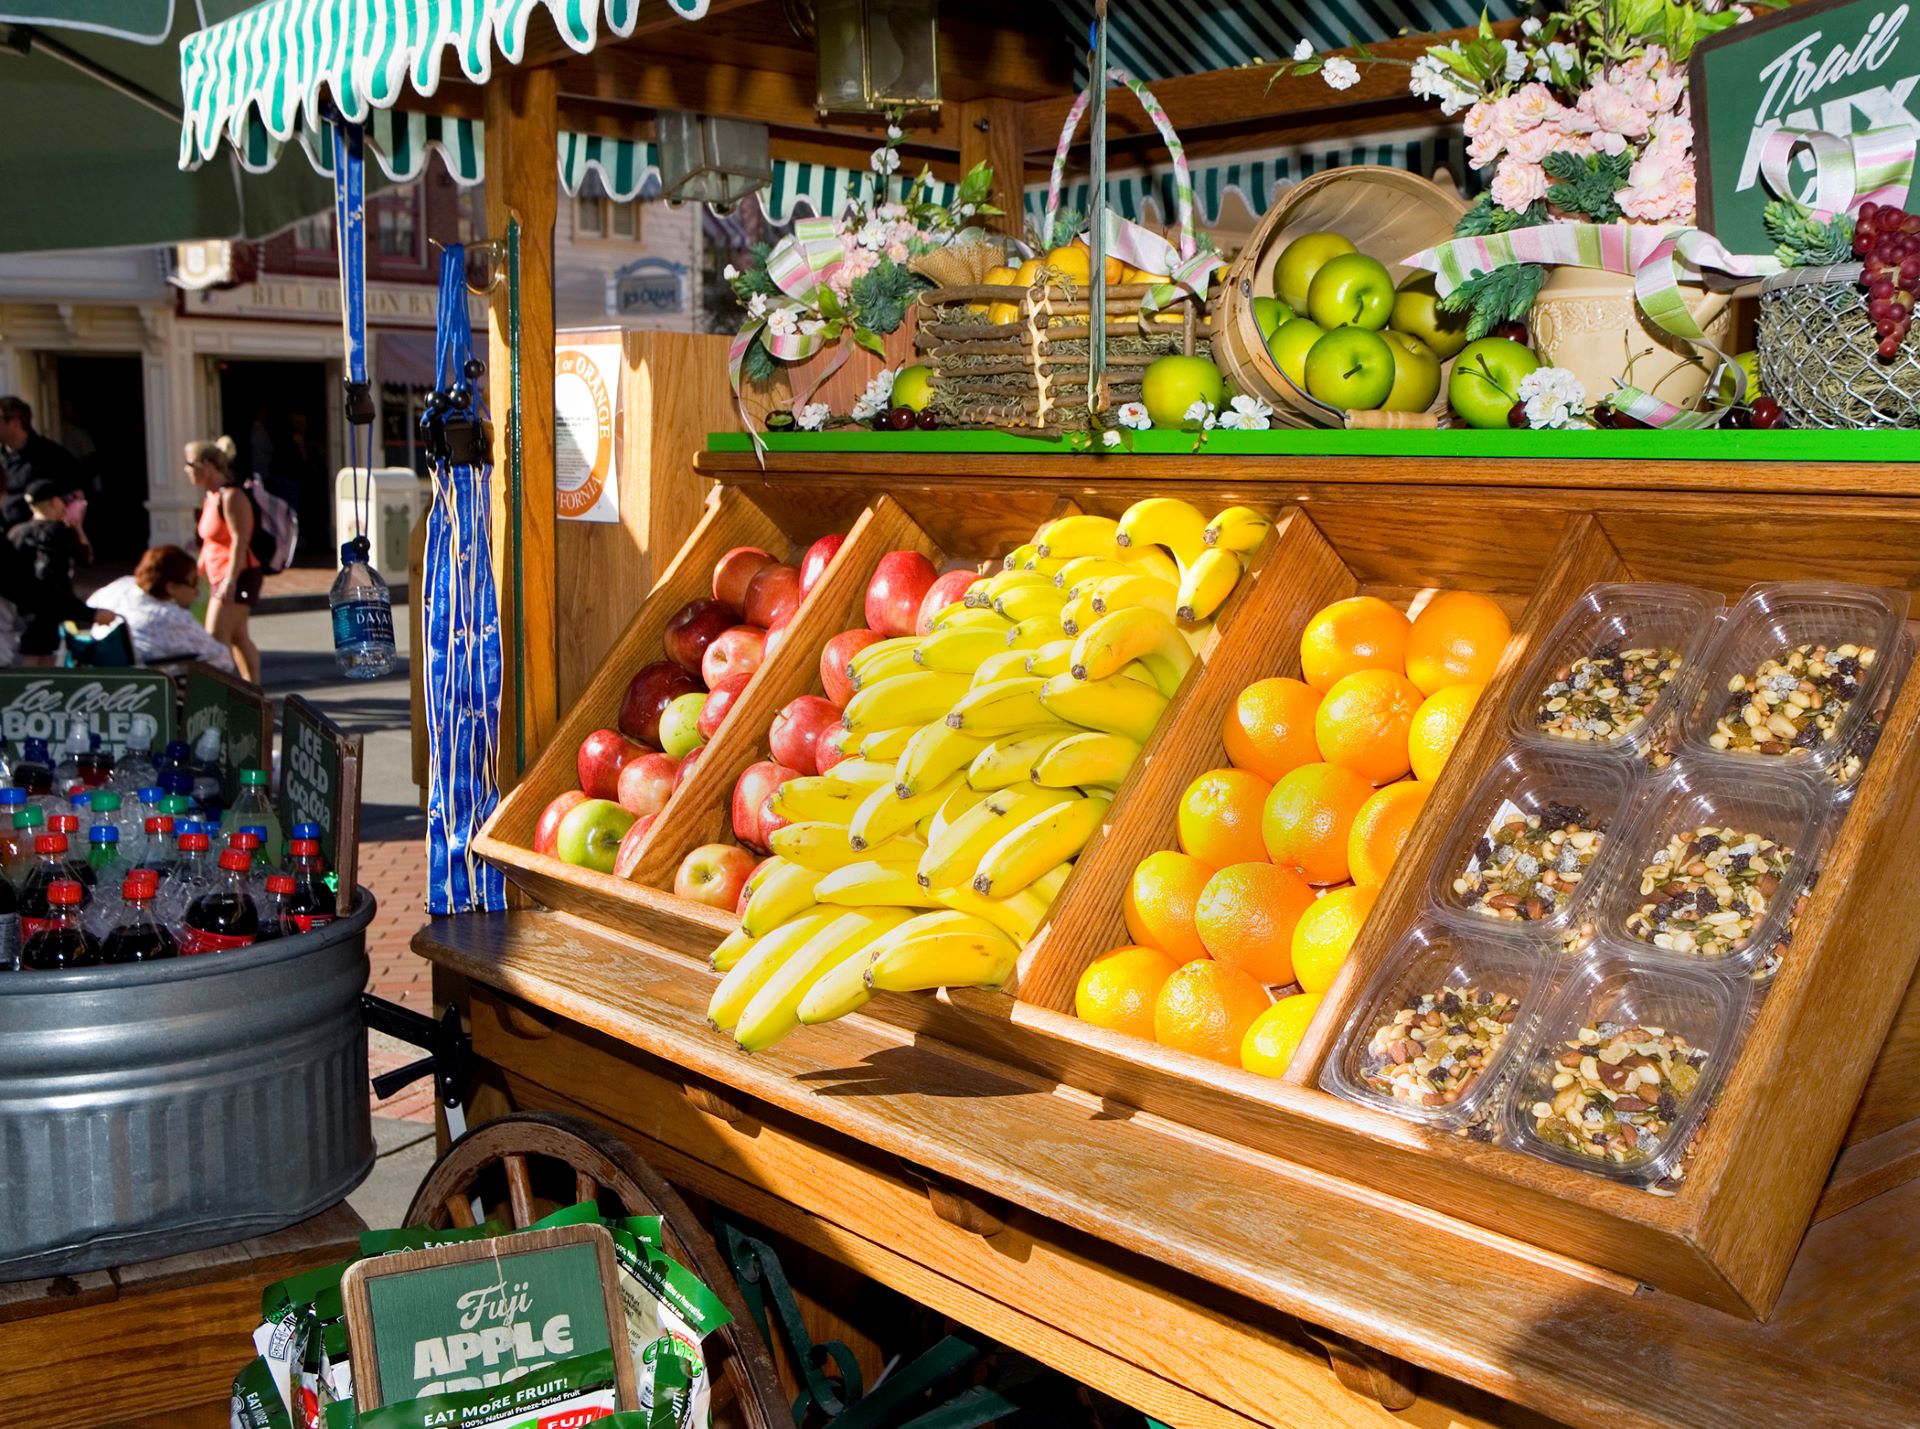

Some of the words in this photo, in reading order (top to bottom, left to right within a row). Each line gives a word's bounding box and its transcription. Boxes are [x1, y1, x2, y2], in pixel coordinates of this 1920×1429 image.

[1755, 4, 1909, 127] Trail
[562, 360, 574, 371] OF
[576, 356, 610, 440] ORANGE
[2, 680, 63, 713] Ice
[65, 682, 157, 713] Cold
[299, 722, 322, 763] ICE
[291, 744, 328, 794] COLD
[456, 1281, 533, 1330] Fuji
[414, 1314, 574, 1379] APPLE
[246, 1392, 262, 1410] EAT
[424, 1411, 456, 1427] EAT
[462, 1395, 511, 1418] MORE
[516, 1378, 568, 1403] FRUIT!
[461, 1418, 484, 1429] 100%
[485, 1408, 514, 1423] Natural
[515, 1395, 562, 1414] Freeze-Dried
[563, 1389, 581, 1400] Fruit
[547, 1413, 592, 1429] FUJI
